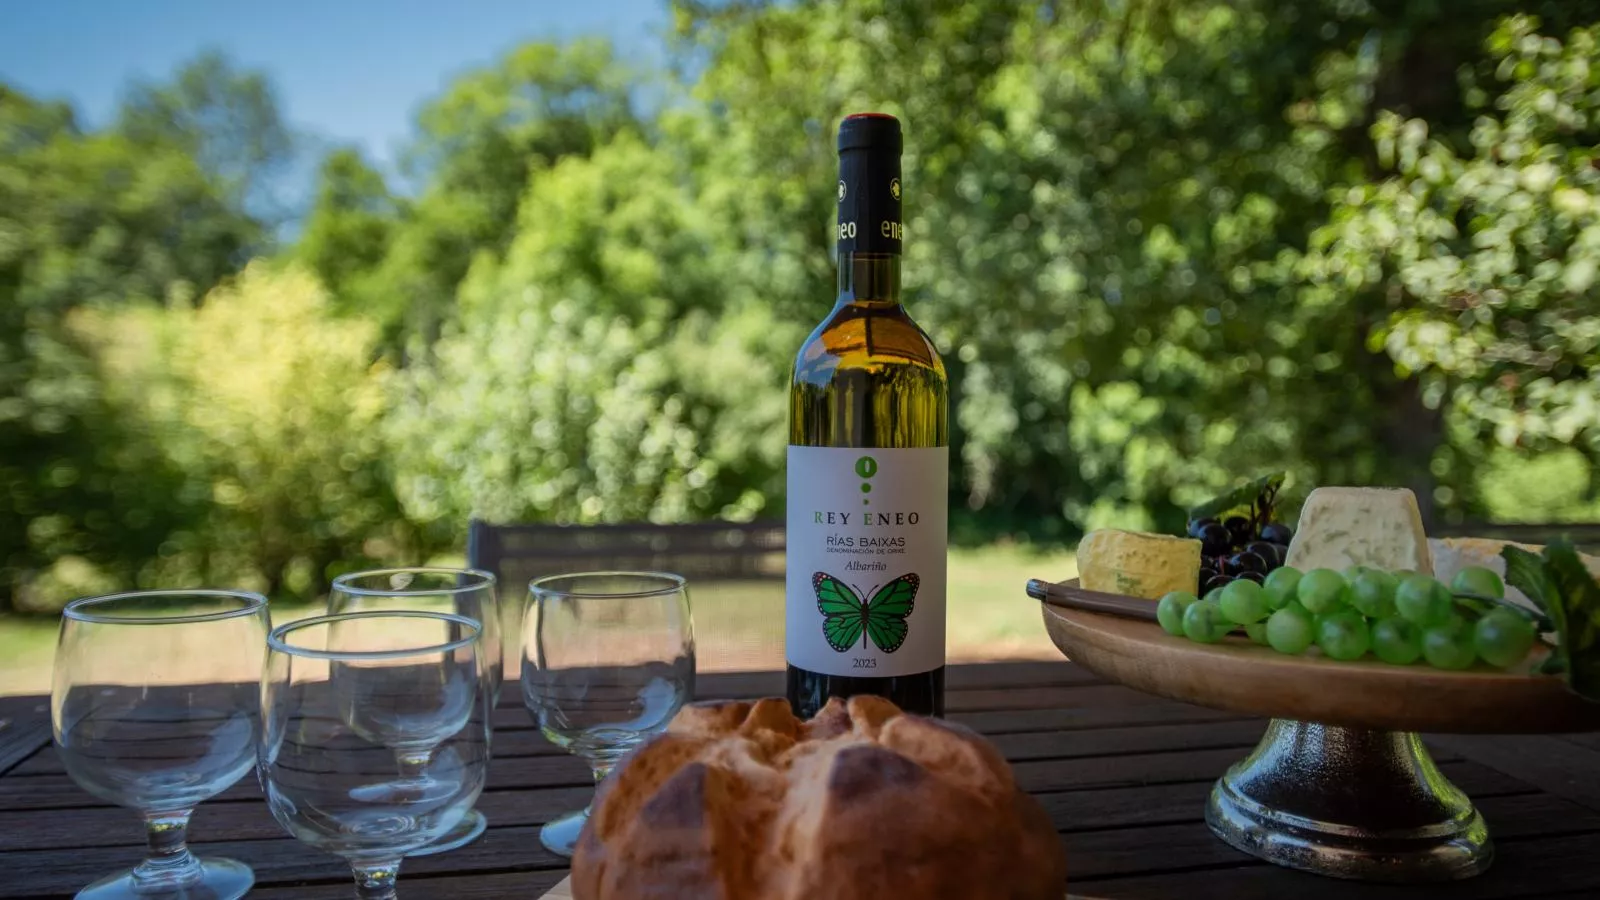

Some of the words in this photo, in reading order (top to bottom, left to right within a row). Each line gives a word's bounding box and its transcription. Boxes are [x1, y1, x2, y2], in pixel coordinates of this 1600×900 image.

[814, 511, 850, 525] REY
[864, 512, 919, 526] ENEO
[826, 533, 854, 547] RÍAS
[860, 537, 906, 547] BAIXAS
[844, 561, 887, 572] Albariño
[852, 658, 877, 669] 2023
